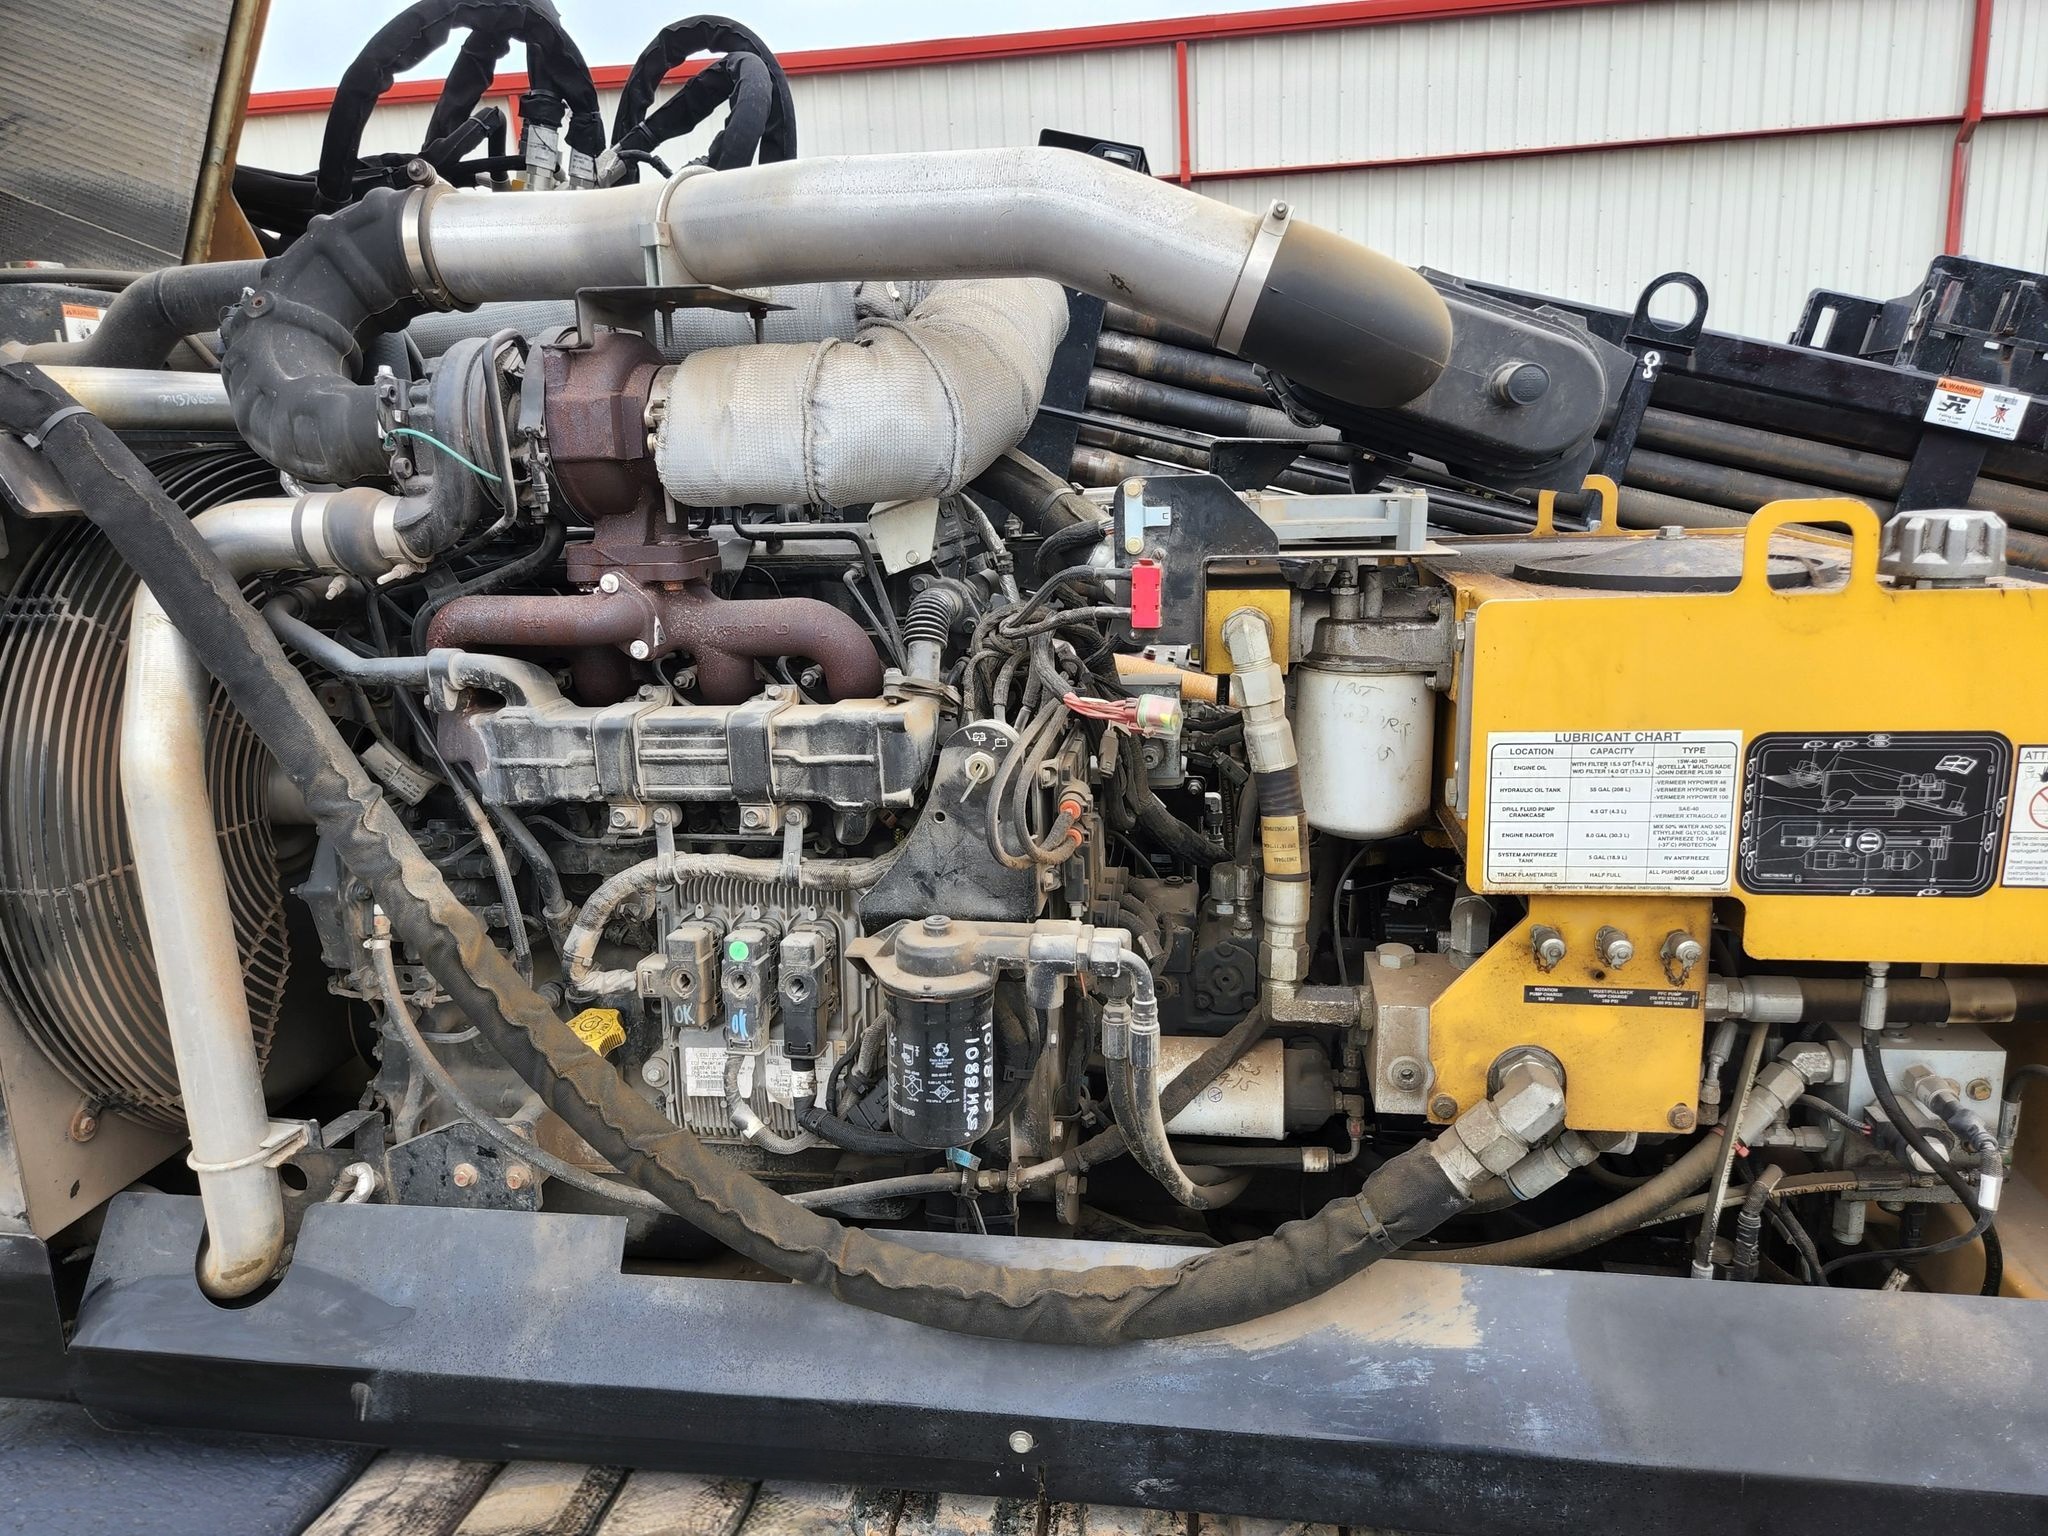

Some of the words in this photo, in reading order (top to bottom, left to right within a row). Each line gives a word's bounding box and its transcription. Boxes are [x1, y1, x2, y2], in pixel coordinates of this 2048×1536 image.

[1949, 382, 1984, 395] WARNING
[1555, 732, 1631, 743] LUBRICANT
[1635, 732, 1681, 742] CHART
[1590, 747, 1634, 755] CAPACITY
[2024, 751, 2048, 760] ATT
[732, 1009, 749, 1040] OK
